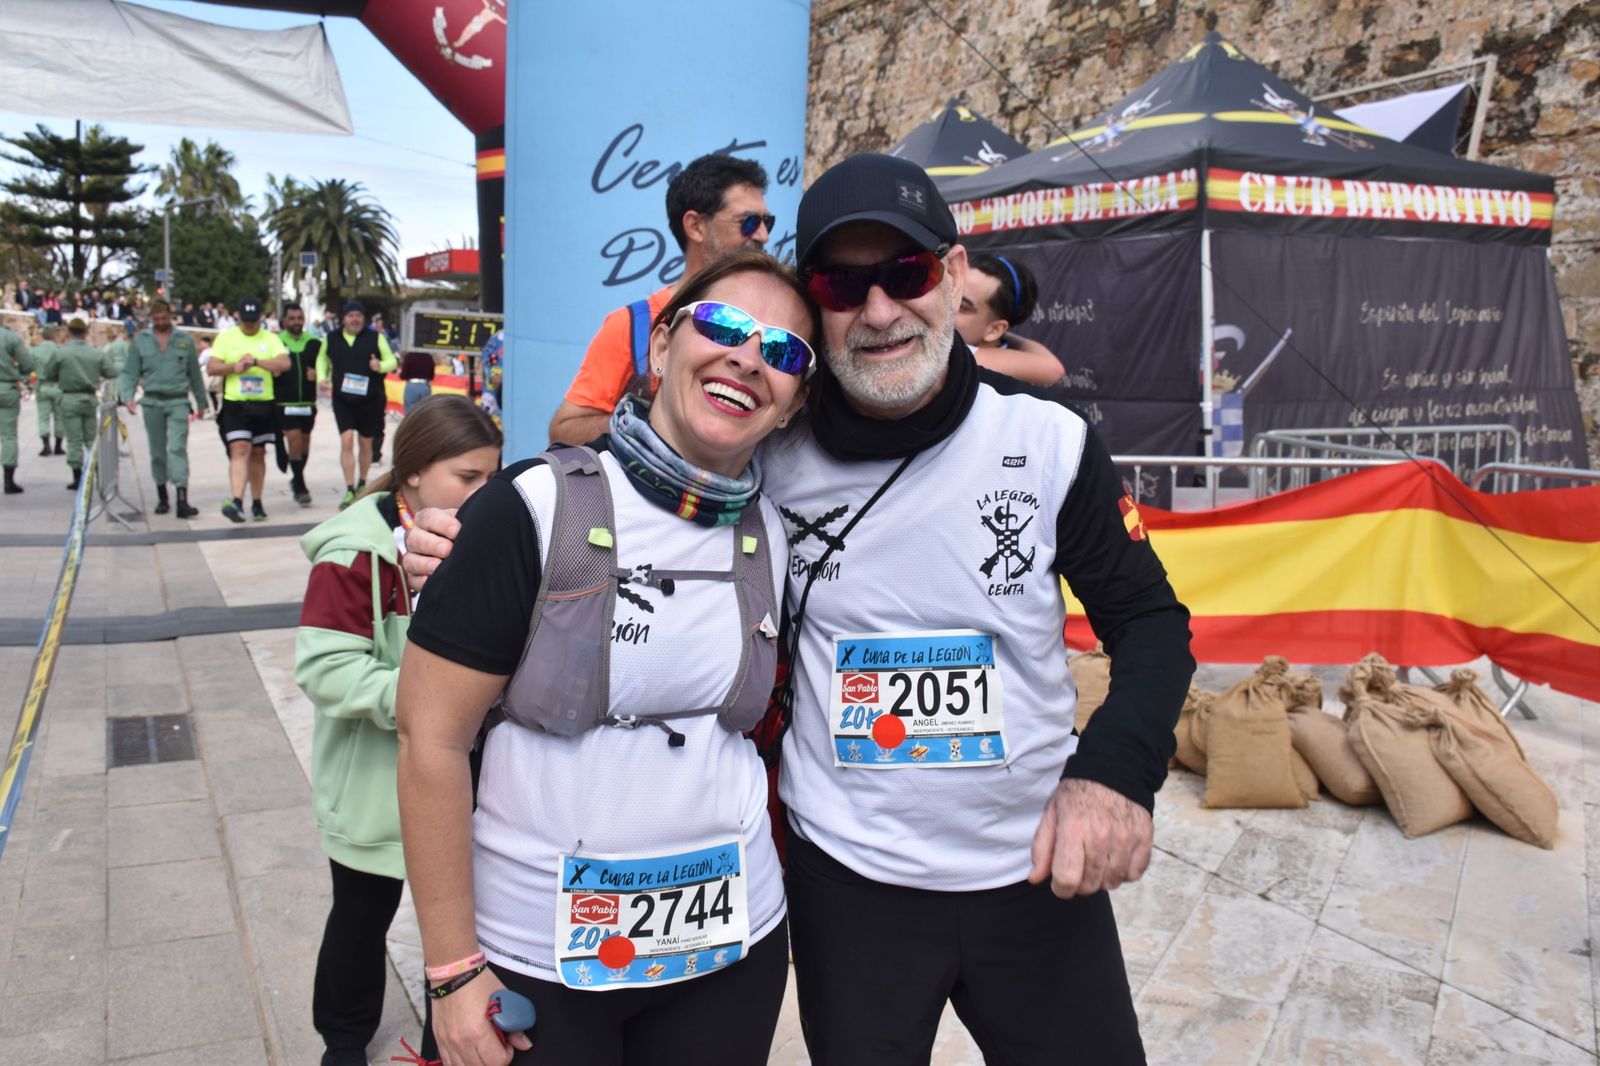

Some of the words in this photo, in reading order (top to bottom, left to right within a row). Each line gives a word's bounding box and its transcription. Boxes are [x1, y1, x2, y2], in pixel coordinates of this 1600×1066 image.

[776, 155, 800, 187] es
[1072, 183, 1103, 222] DE
[1239, 171, 1335, 216] CLUB
[1341, 179, 1531, 226] DEPORTIVO
[1003, 457, 1025, 467] 42K
[977, 494, 991, 510] LA
[988, 583, 1024, 596] CEUTA
[841, 644, 856, 666] X
[863, 648, 889, 665] Cuna
[843, 684, 857, 693] San
[857, 682, 879, 693] Pablo
[889, 670, 988, 717] 2051
[913, 719, 939, 727] ANGEL
[569, 863, 590, 885] X
[600, 868, 634, 886] Cuna
[571, 903, 590, 914] San
[591, 904, 618, 915] Pablo
[628, 880, 733, 938] 2744
[656, 936, 680, 946] YANAÍ
